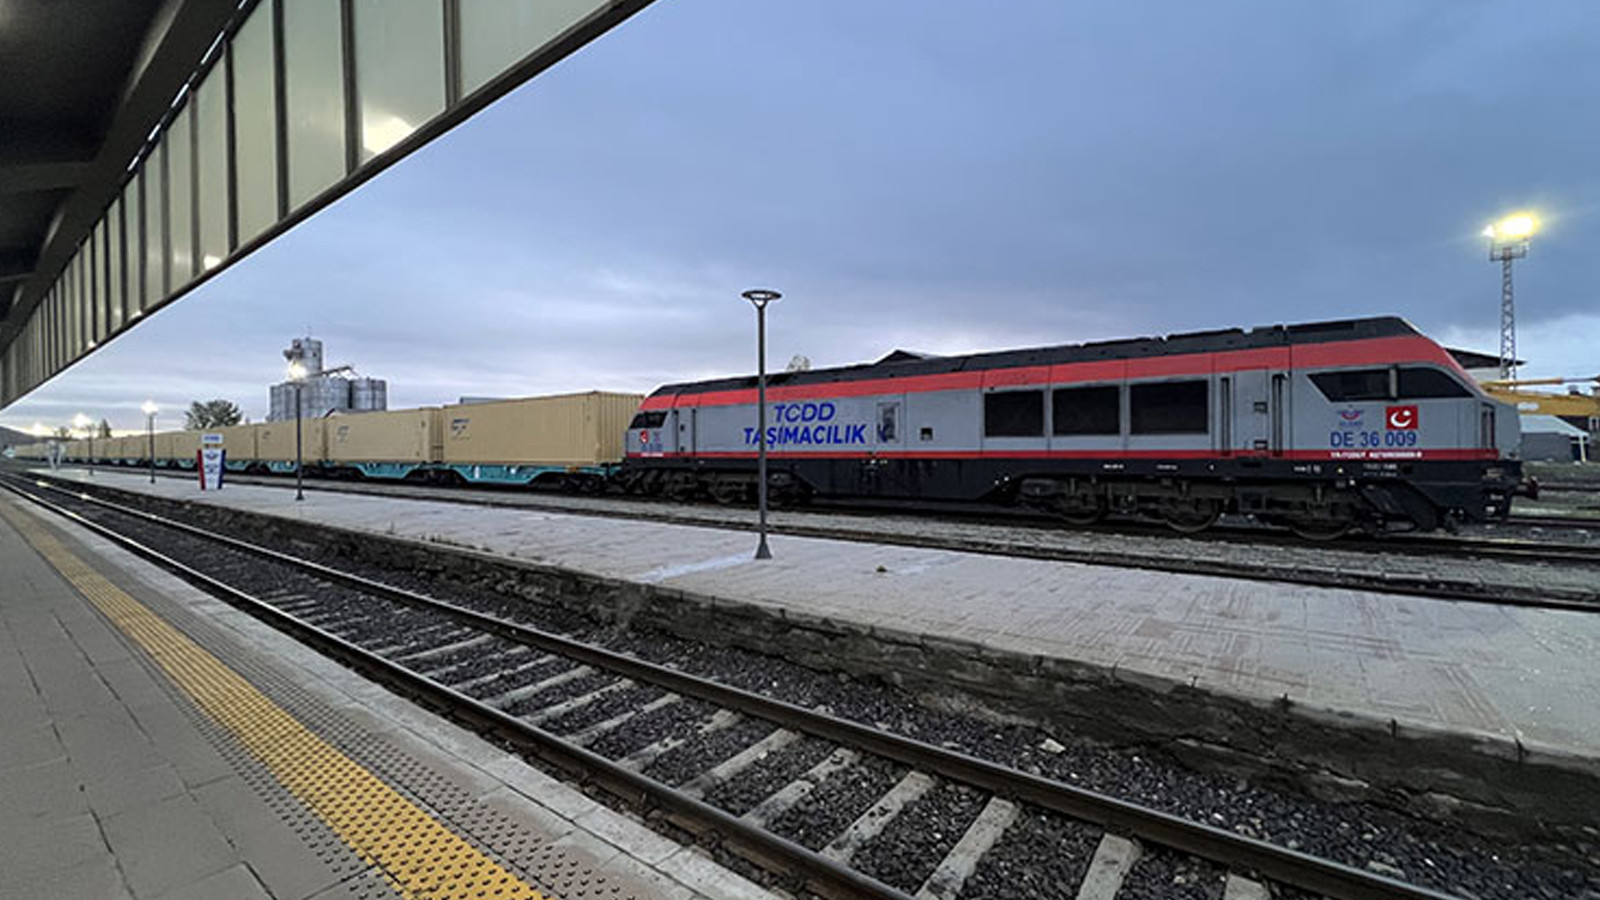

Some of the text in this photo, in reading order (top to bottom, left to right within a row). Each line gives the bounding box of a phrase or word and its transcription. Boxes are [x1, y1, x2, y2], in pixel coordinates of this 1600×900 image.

[774, 402, 836, 423] TCDD
[1330, 431, 1416, 447] DE 36 009
